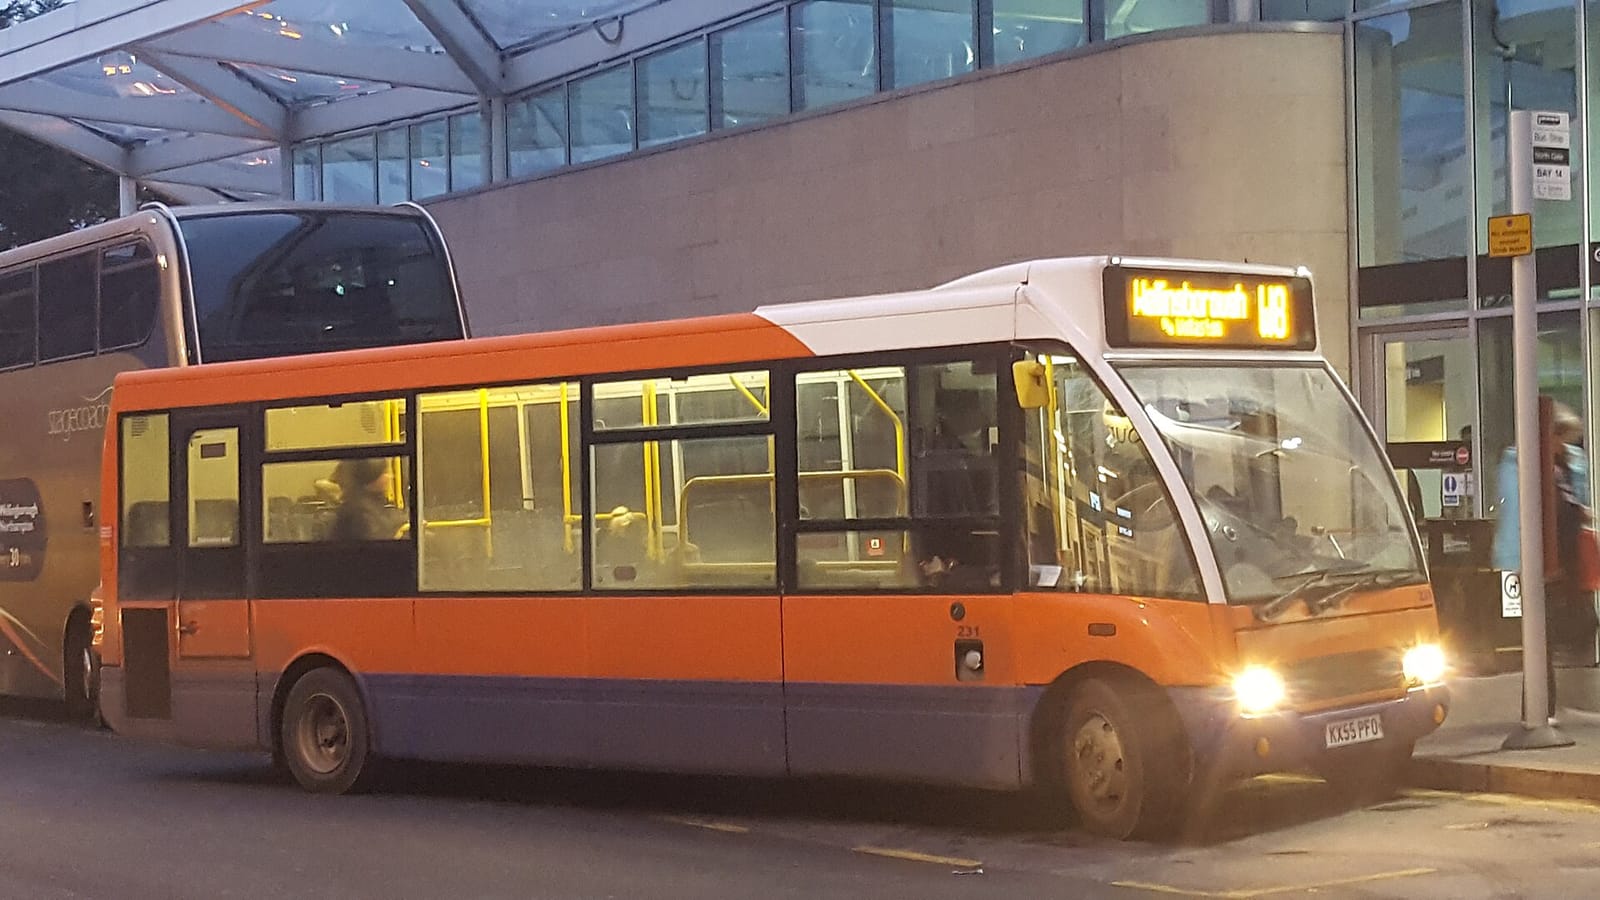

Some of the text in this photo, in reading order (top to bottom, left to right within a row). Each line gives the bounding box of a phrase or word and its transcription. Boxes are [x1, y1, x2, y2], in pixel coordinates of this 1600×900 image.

[1536, 168, 1562, 177] BAY 14
[957, 625, 980, 637] 231
[1329, 721, 1357, 744] KX55
